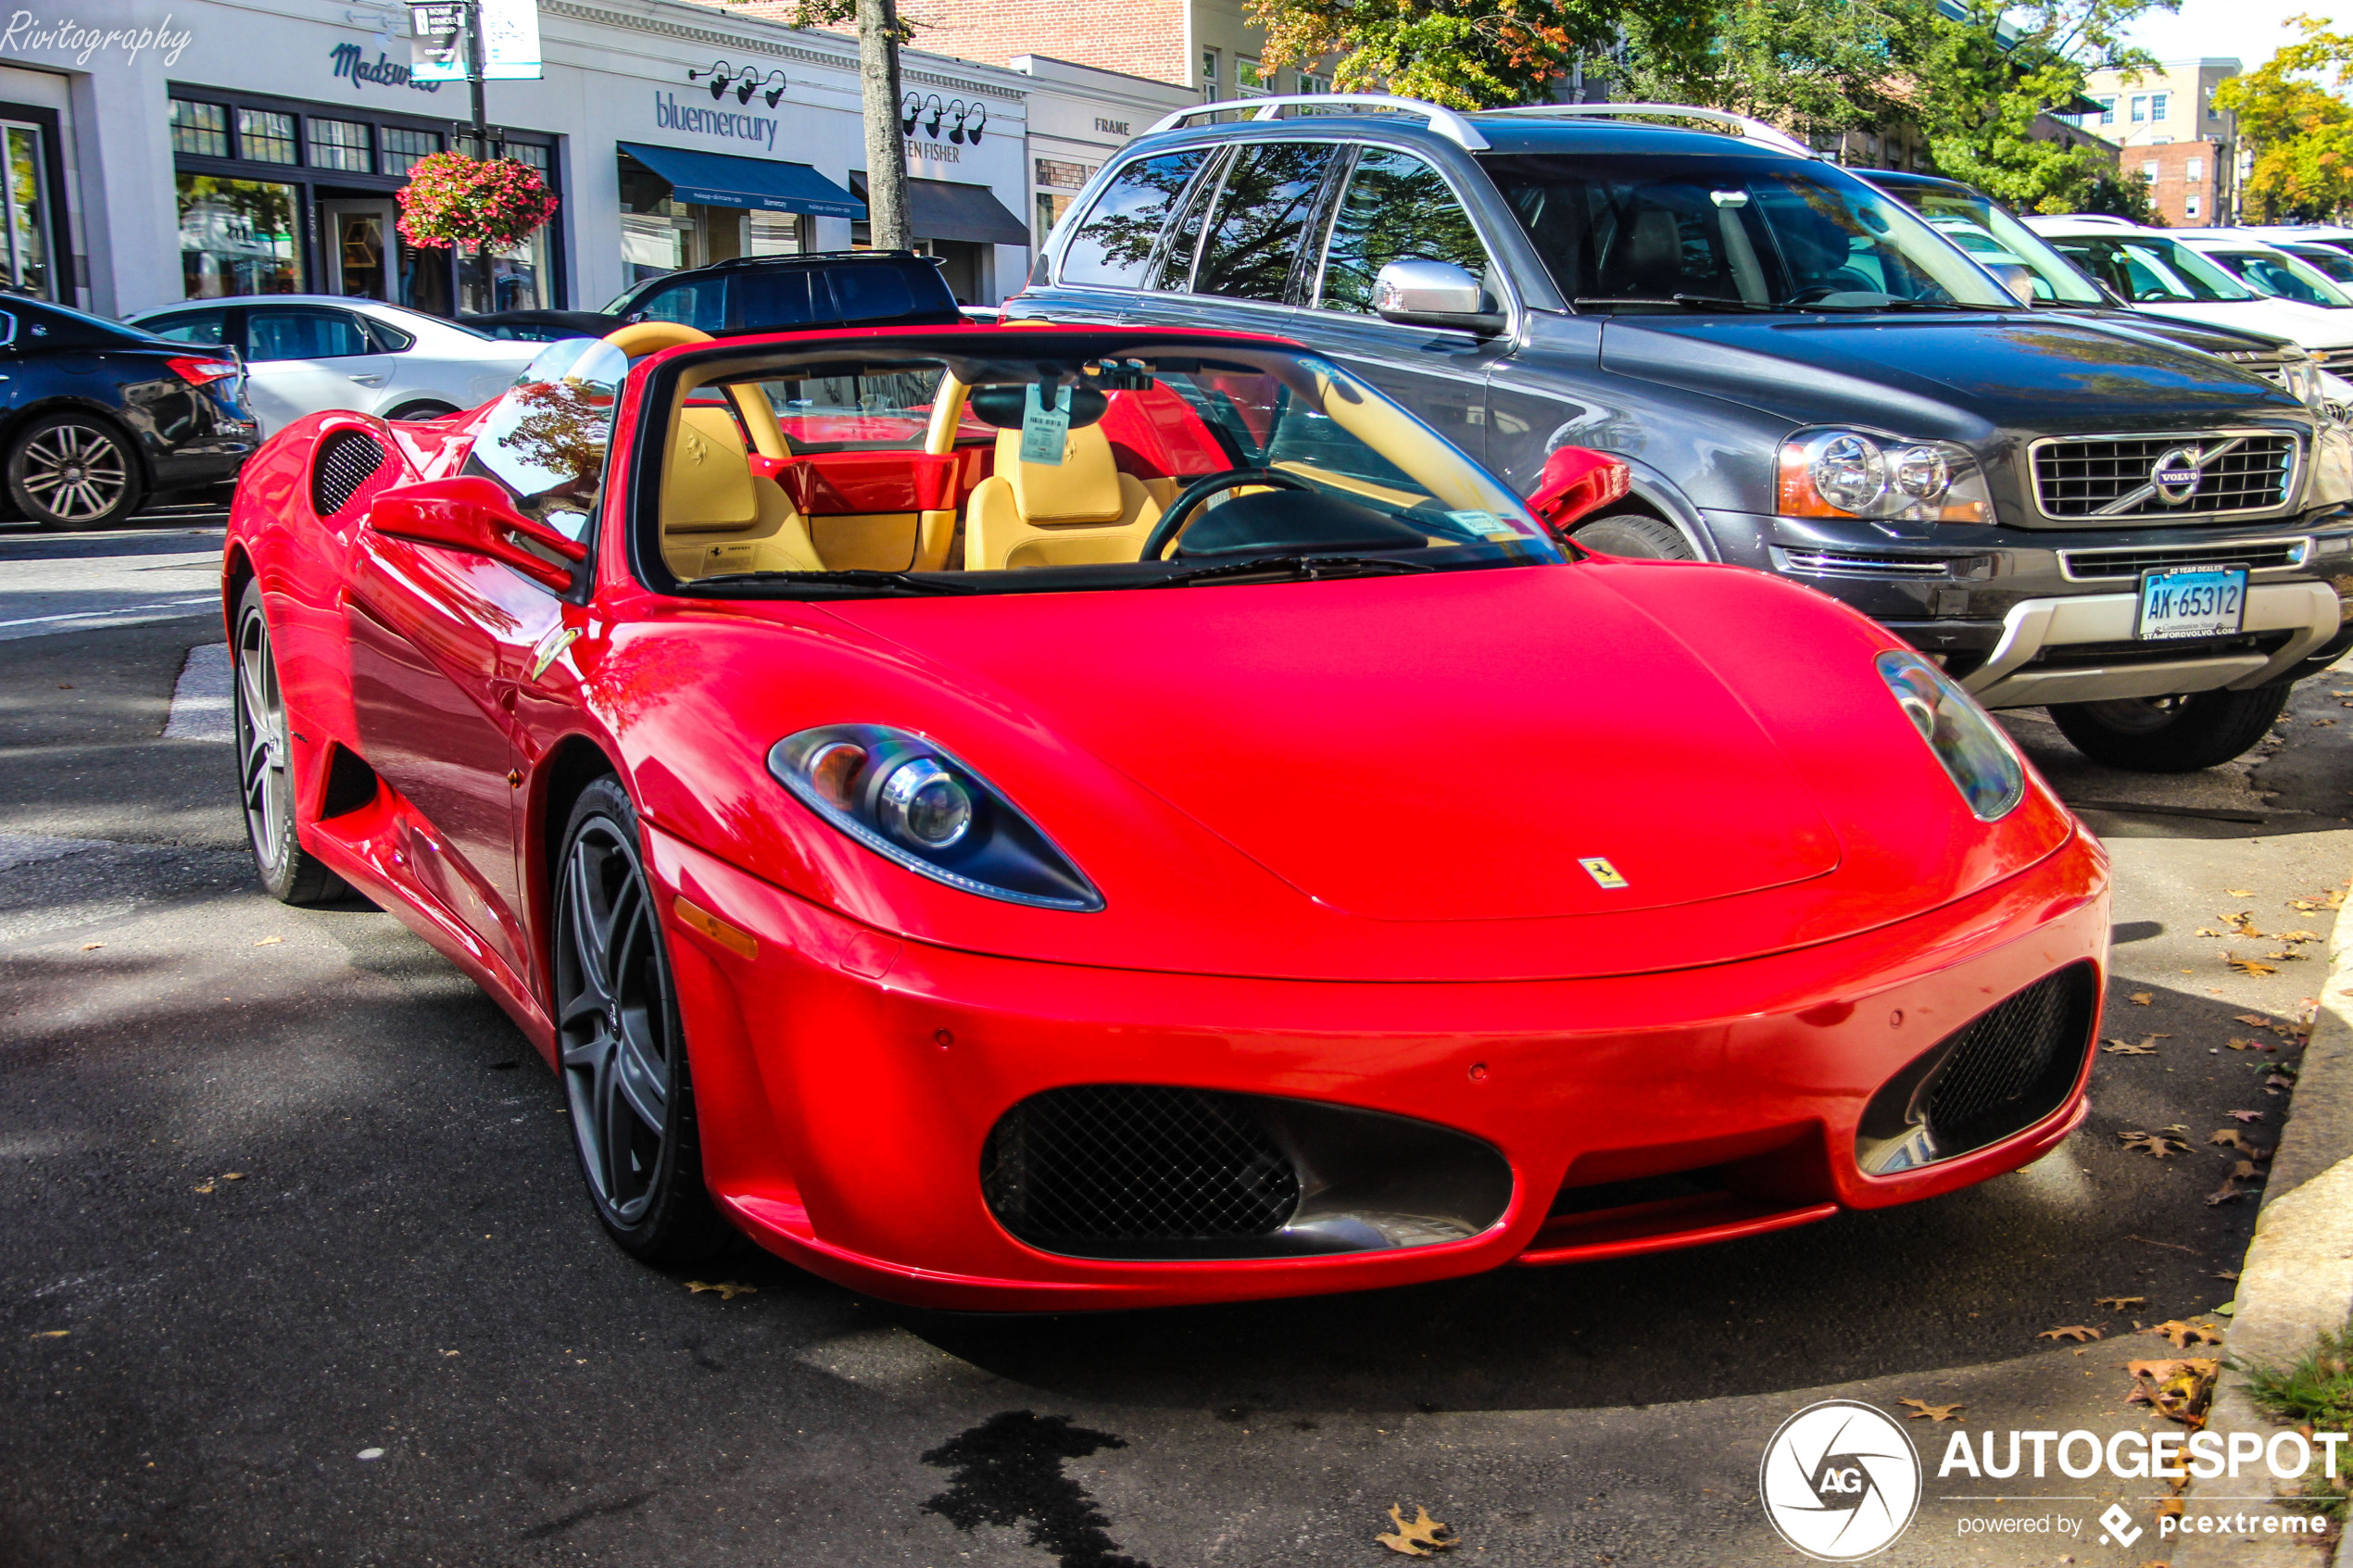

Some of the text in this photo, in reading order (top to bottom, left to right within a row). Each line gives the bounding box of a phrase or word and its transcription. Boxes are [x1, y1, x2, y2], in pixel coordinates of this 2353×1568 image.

[656, 90, 778, 152] bluemercury
[1095, 117, 1131, 136] FRAME
[925, 143, 961, 164] FISHER
[2160, 472, 2197, 482] VOLVO
[2179, 566, 2196, 574] YEAR
[2196, 565, 2223, 573] DEALER
[2200, 621, 2215, 630] State
